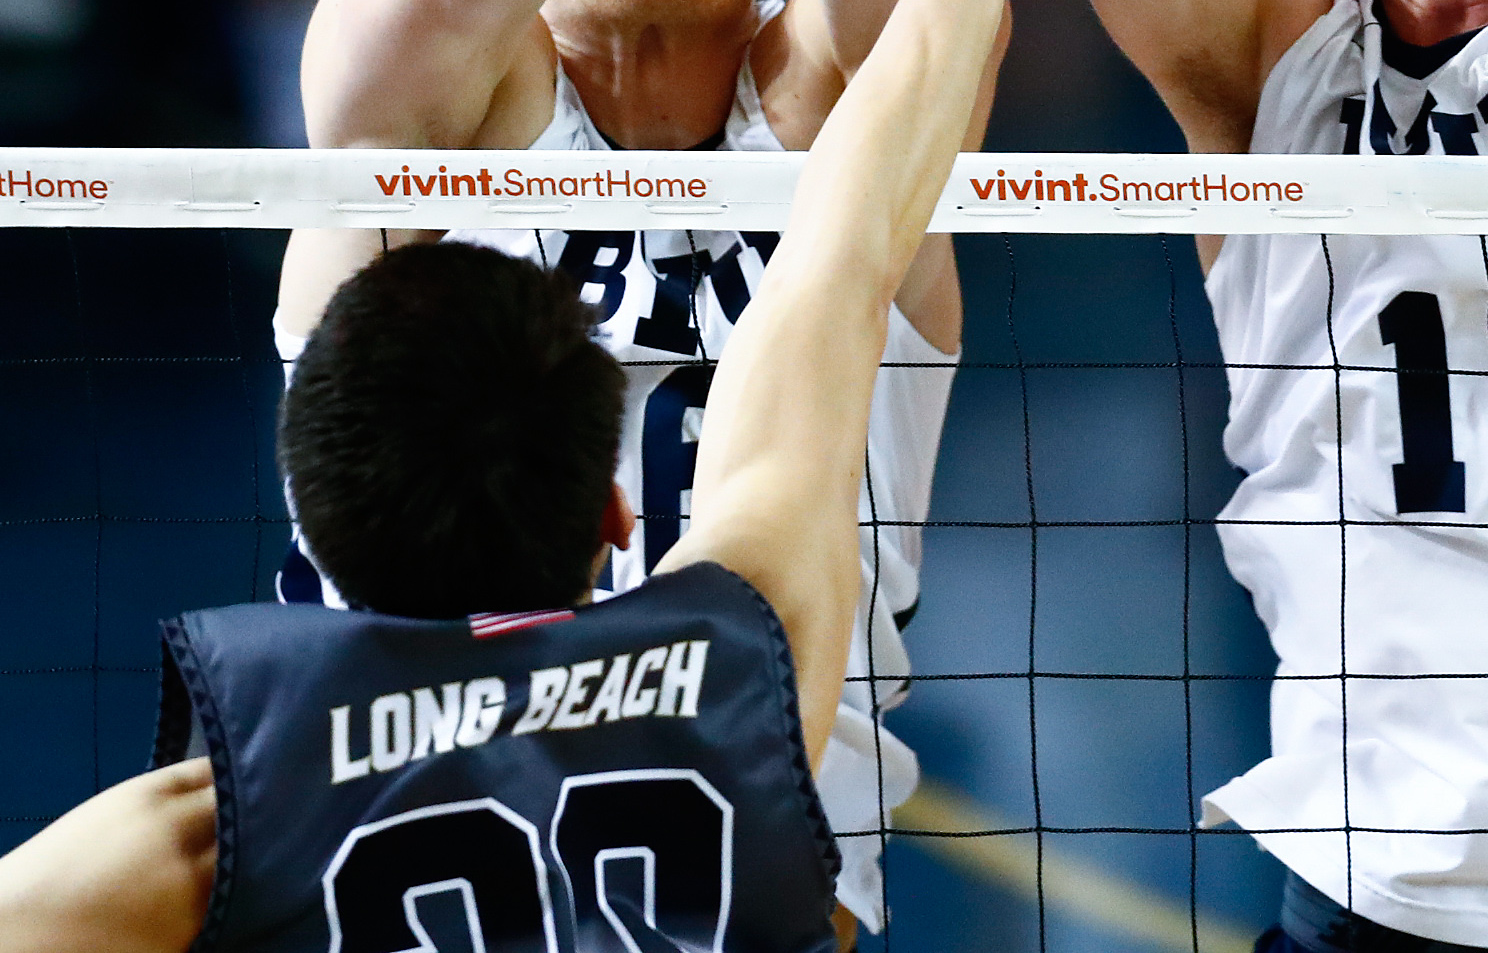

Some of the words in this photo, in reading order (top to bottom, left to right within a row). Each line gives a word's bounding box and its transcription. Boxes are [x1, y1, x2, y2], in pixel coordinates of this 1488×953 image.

[1378, 291, 1466, 514] 1
[330, 676, 506, 784] LONG
[511, 640, 710, 736] BEACH
